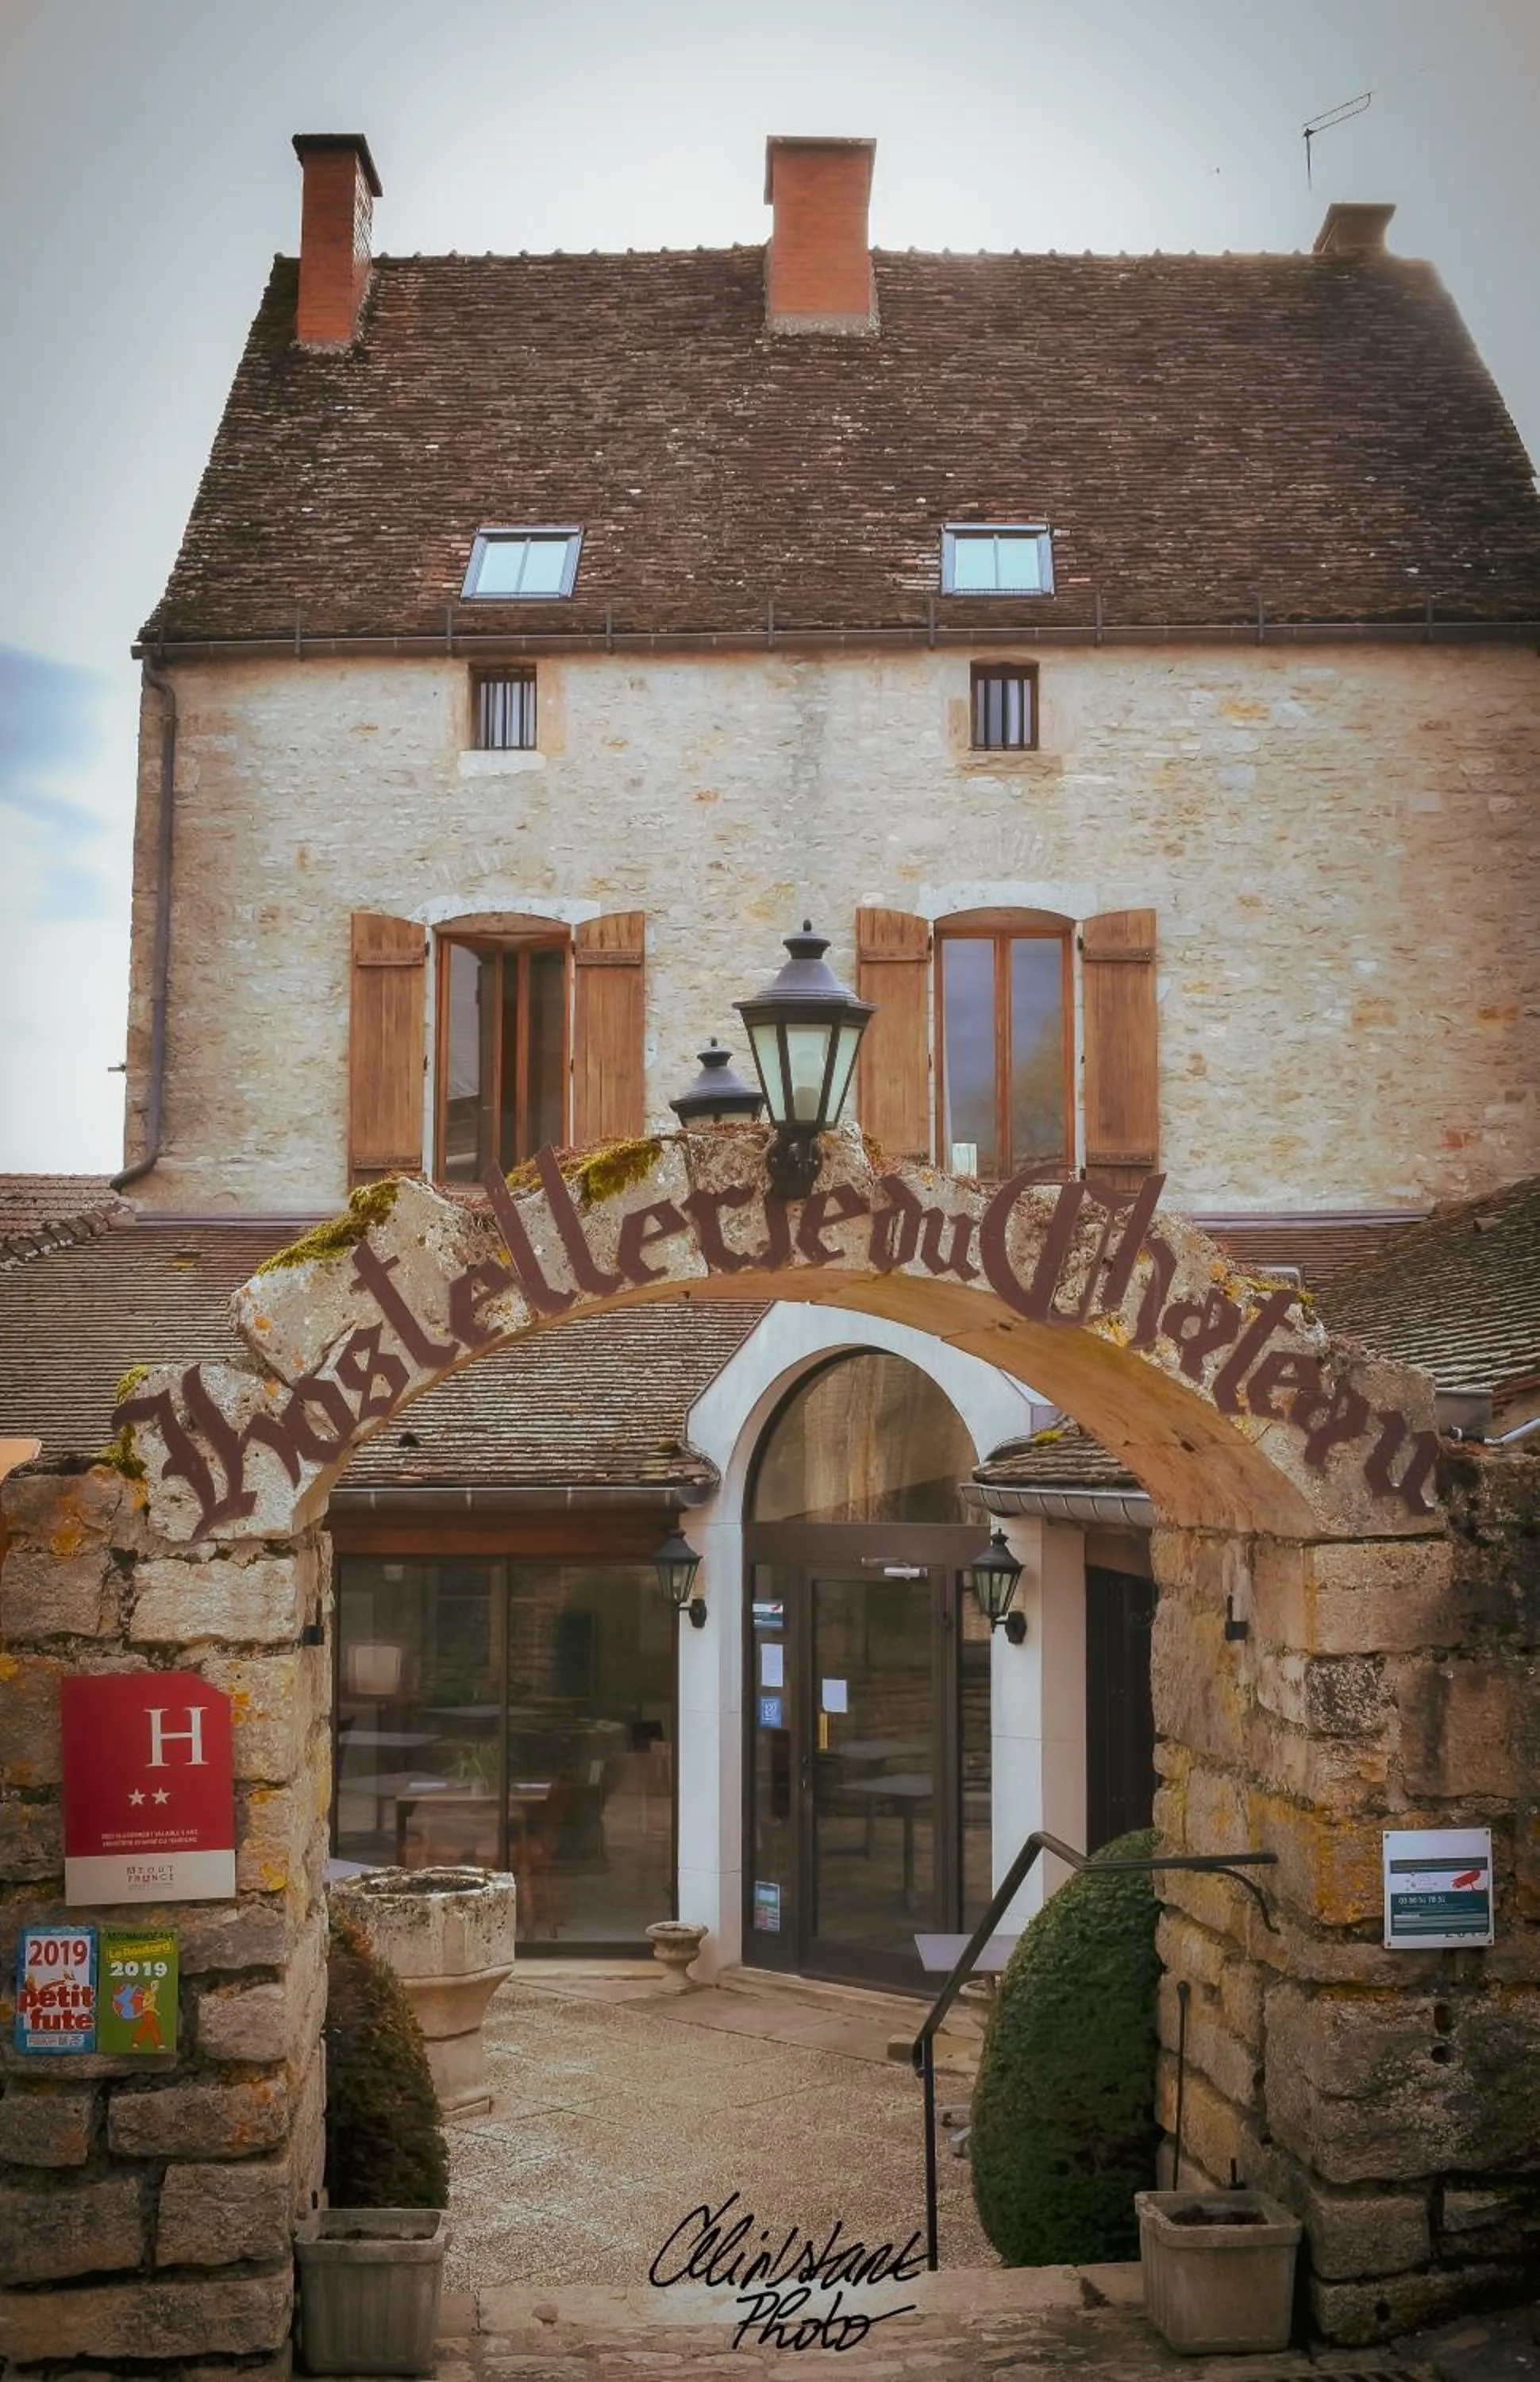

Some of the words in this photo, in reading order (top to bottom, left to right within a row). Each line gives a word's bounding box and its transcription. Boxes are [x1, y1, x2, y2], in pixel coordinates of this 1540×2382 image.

[868, 1174, 981, 1281] du
[143, 1706, 209, 1768] H
[29, 1940, 87, 1967] 2019
[110, 1961, 167, 1977] 2019
[17, 1983, 94, 2014] petit
